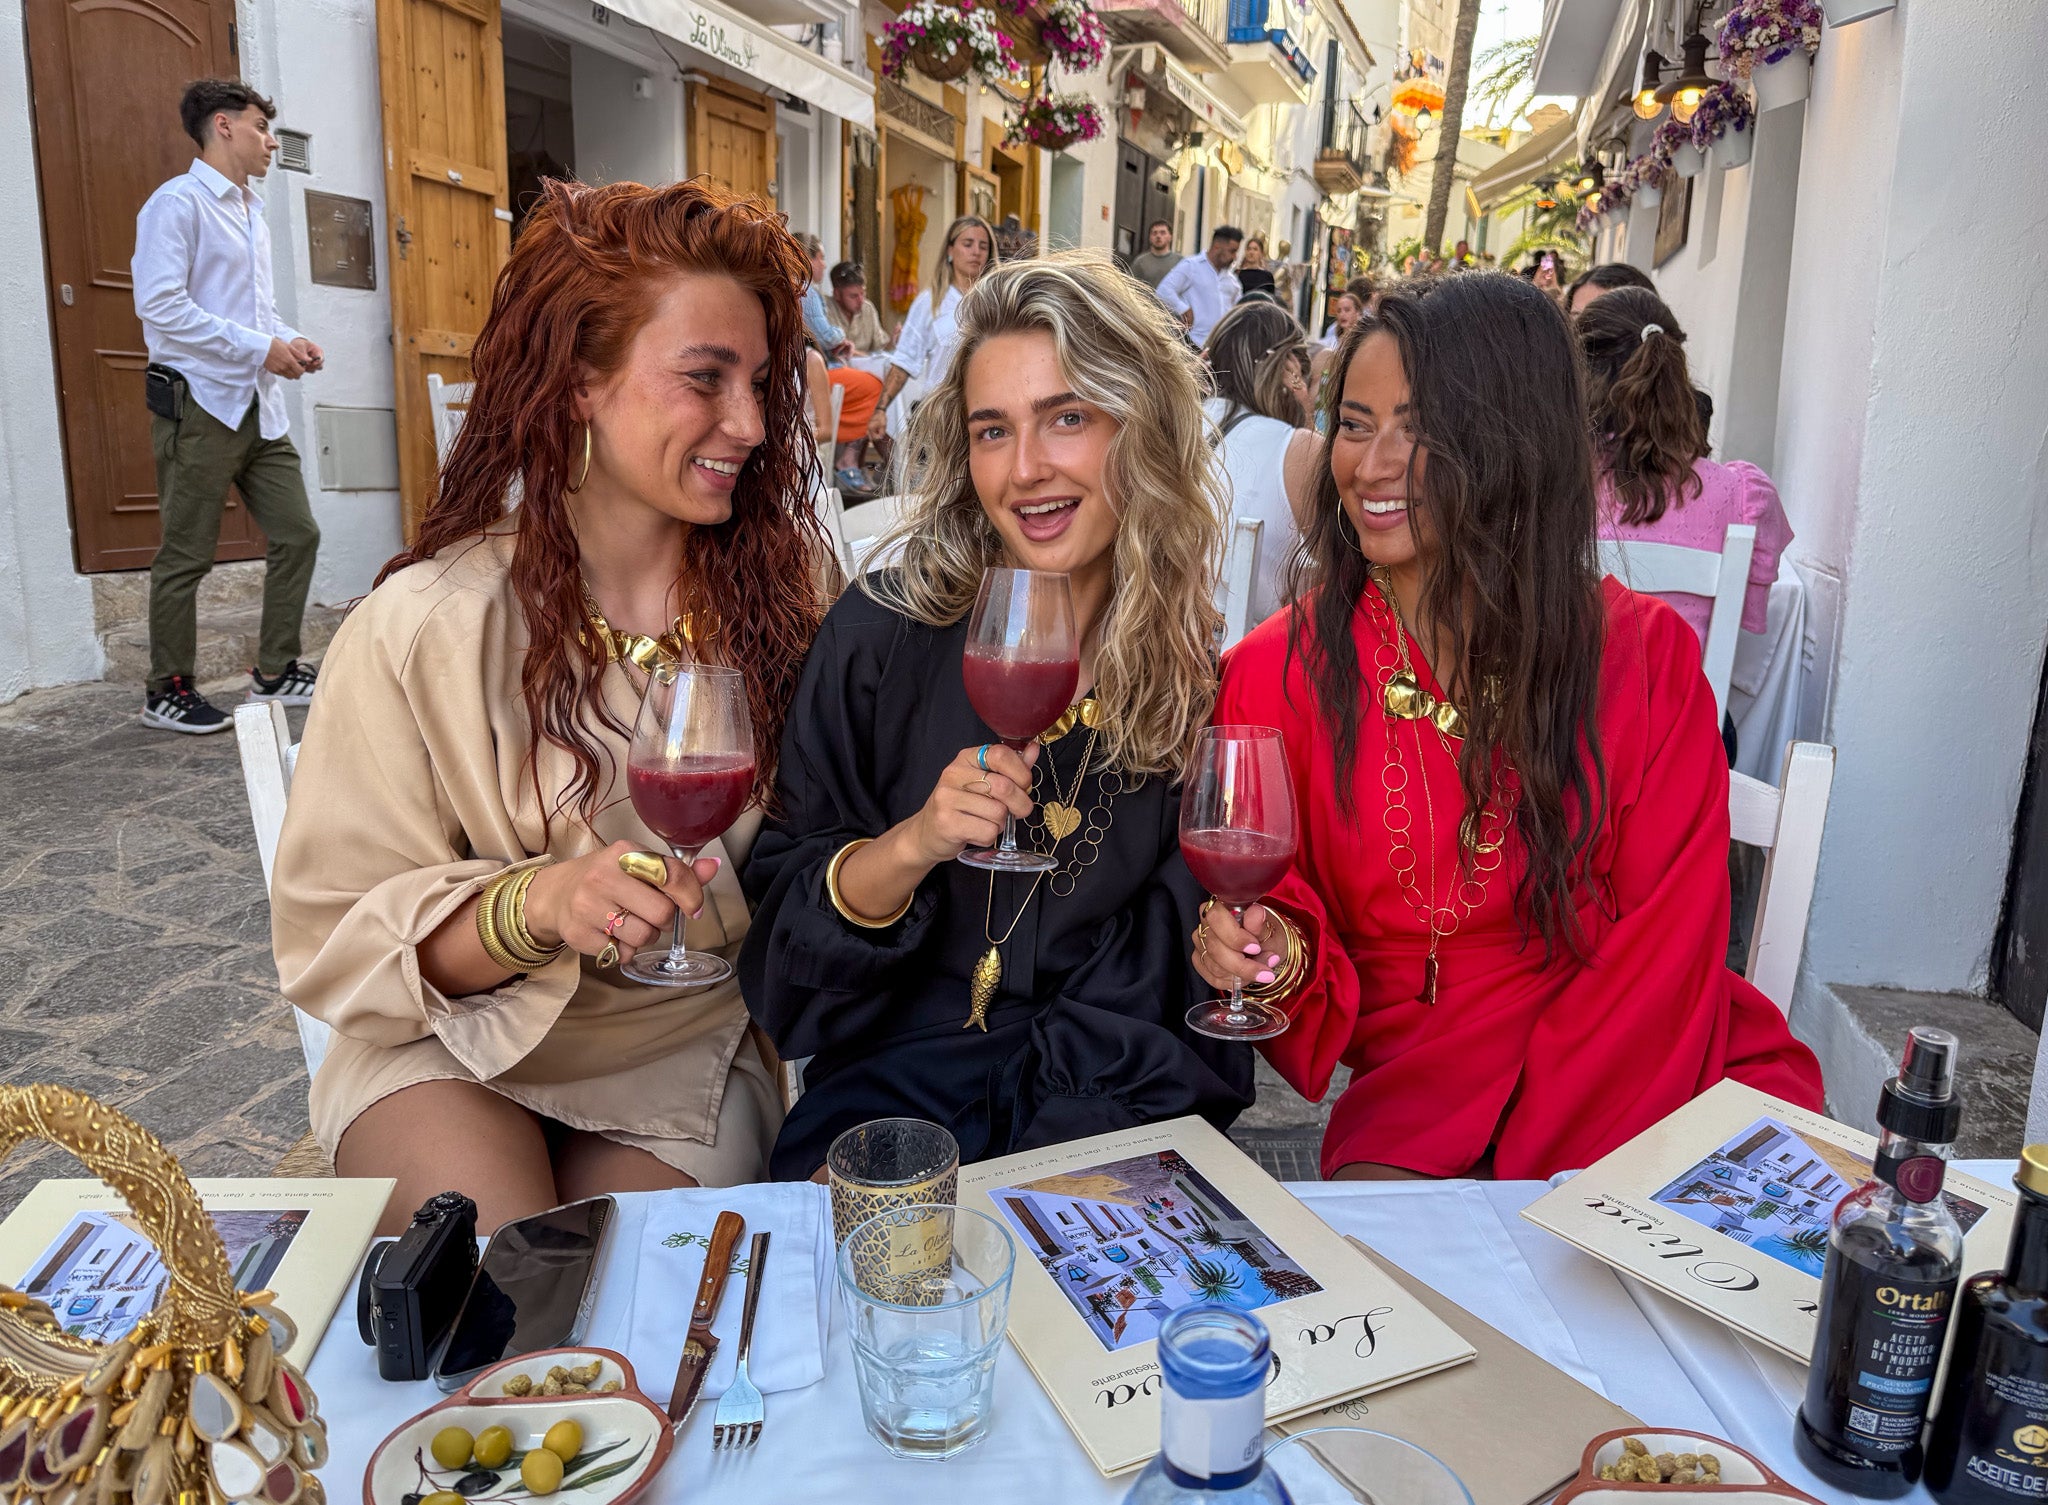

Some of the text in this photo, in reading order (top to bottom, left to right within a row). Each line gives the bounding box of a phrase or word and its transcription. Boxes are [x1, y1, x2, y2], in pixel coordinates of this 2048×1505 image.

[689, 11, 743, 67] La Oliva
[1601, 1193, 1664, 1226] Restaurante
[894, 1243, 918, 1258] La
[1583, 1196, 1760, 1292] Oliva
[1297, 1306, 1394, 1359] La
[1889, 1333, 1926, 1346] ACETO
[1870, 1349, 1883, 1362] DI
[1873, 1338, 1935, 1356] BALSAMICO
[1091, 1361, 1160, 1388] Restaurante
[1885, 1364, 1916, 1377] I.G.P.
[1848, 1433, 1875, 1448] Spray
[1966, 1455, 2022, 1488] ACEITE
[2022, 1475, 2046, 1493] DE
